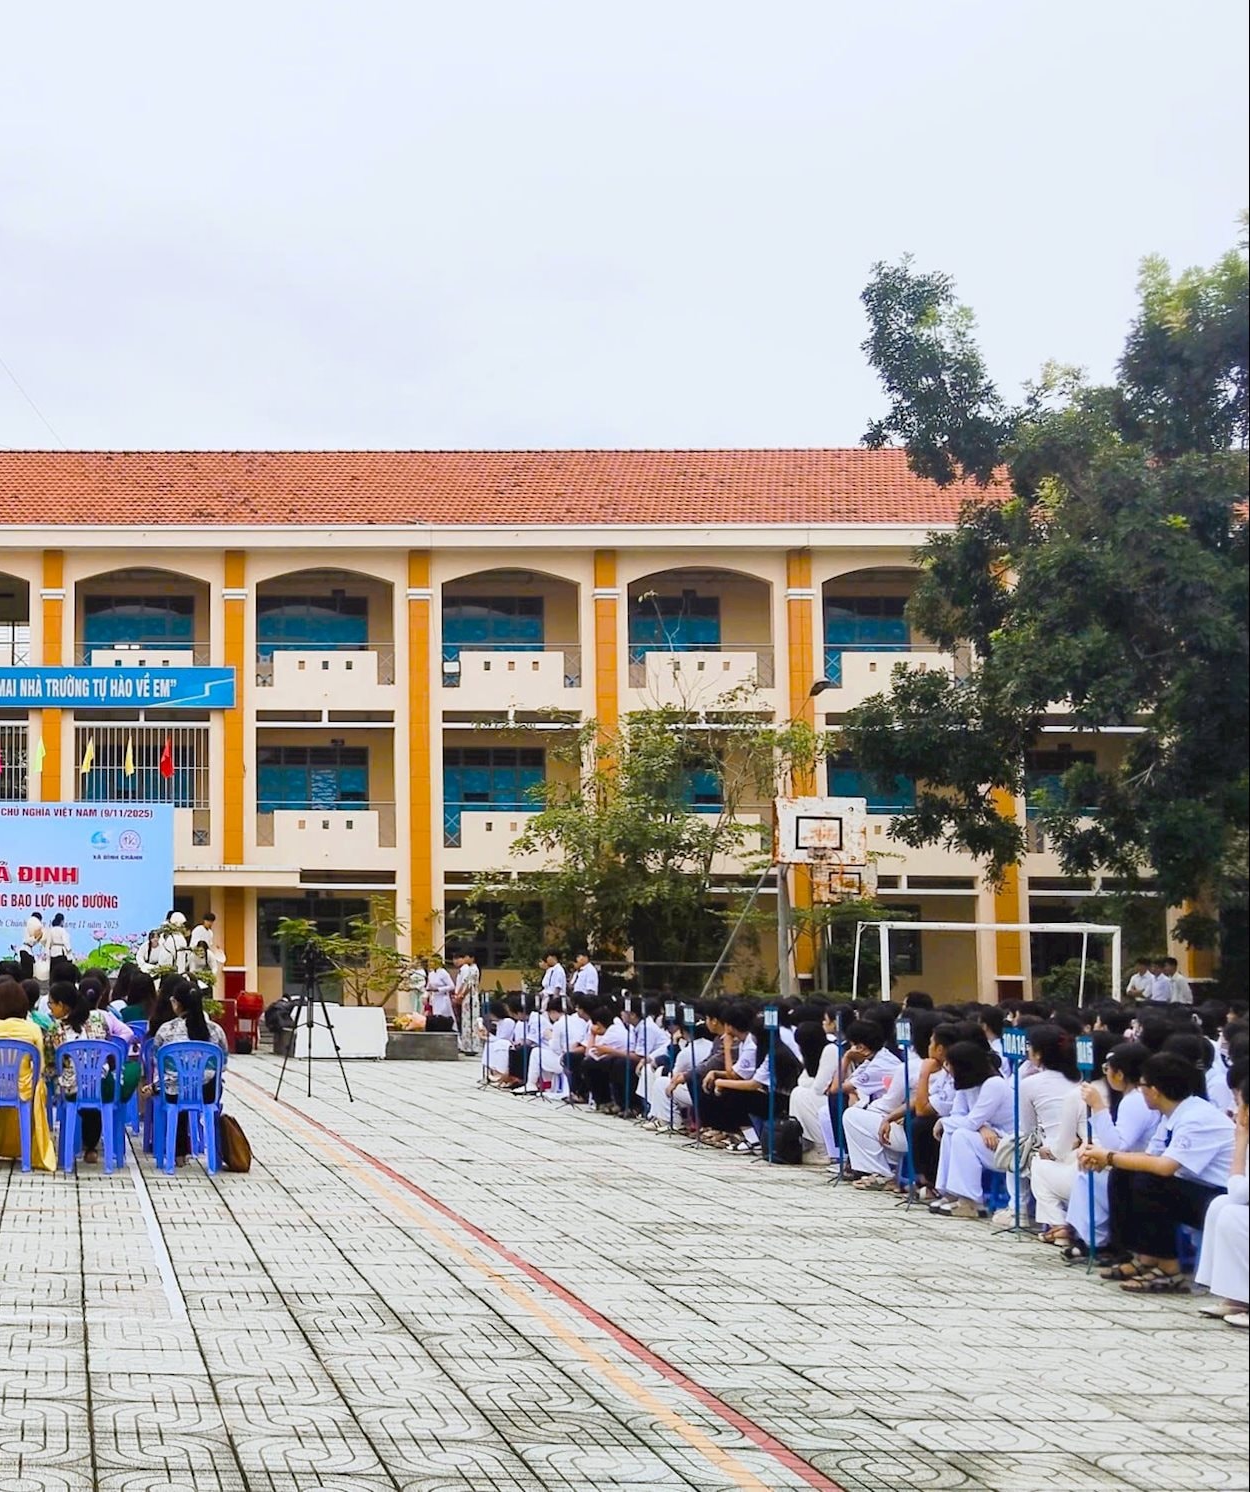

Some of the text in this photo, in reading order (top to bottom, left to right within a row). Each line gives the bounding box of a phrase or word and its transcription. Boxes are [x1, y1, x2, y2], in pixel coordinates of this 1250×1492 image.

[20, 674, 42, 698] NHÀ
[46, 674, 90, 698] TRƯỜNG
[92, 677, 107, 701] TỰ
[110, 674, 132, 698] HÀO
[136, 672, 150, 698] VỀ
[1, 805, 20, 817] CHỦ
[54, 806, 73, 818] VIỆT
[76, 808, 97, 817] NAM
[100, 808, 153, 819] (9/11/2025)
[18, 865, 79, 887] ĐỊNH
[11, 893, 32, 910] BẠO
[35, 892, 55, 911] LỰC
[58, 893, 78, 911] HỌC
[82, 891, 118, 909] ĐƯỜNG
[1002, 1032, 1026, 1056] 10A14
